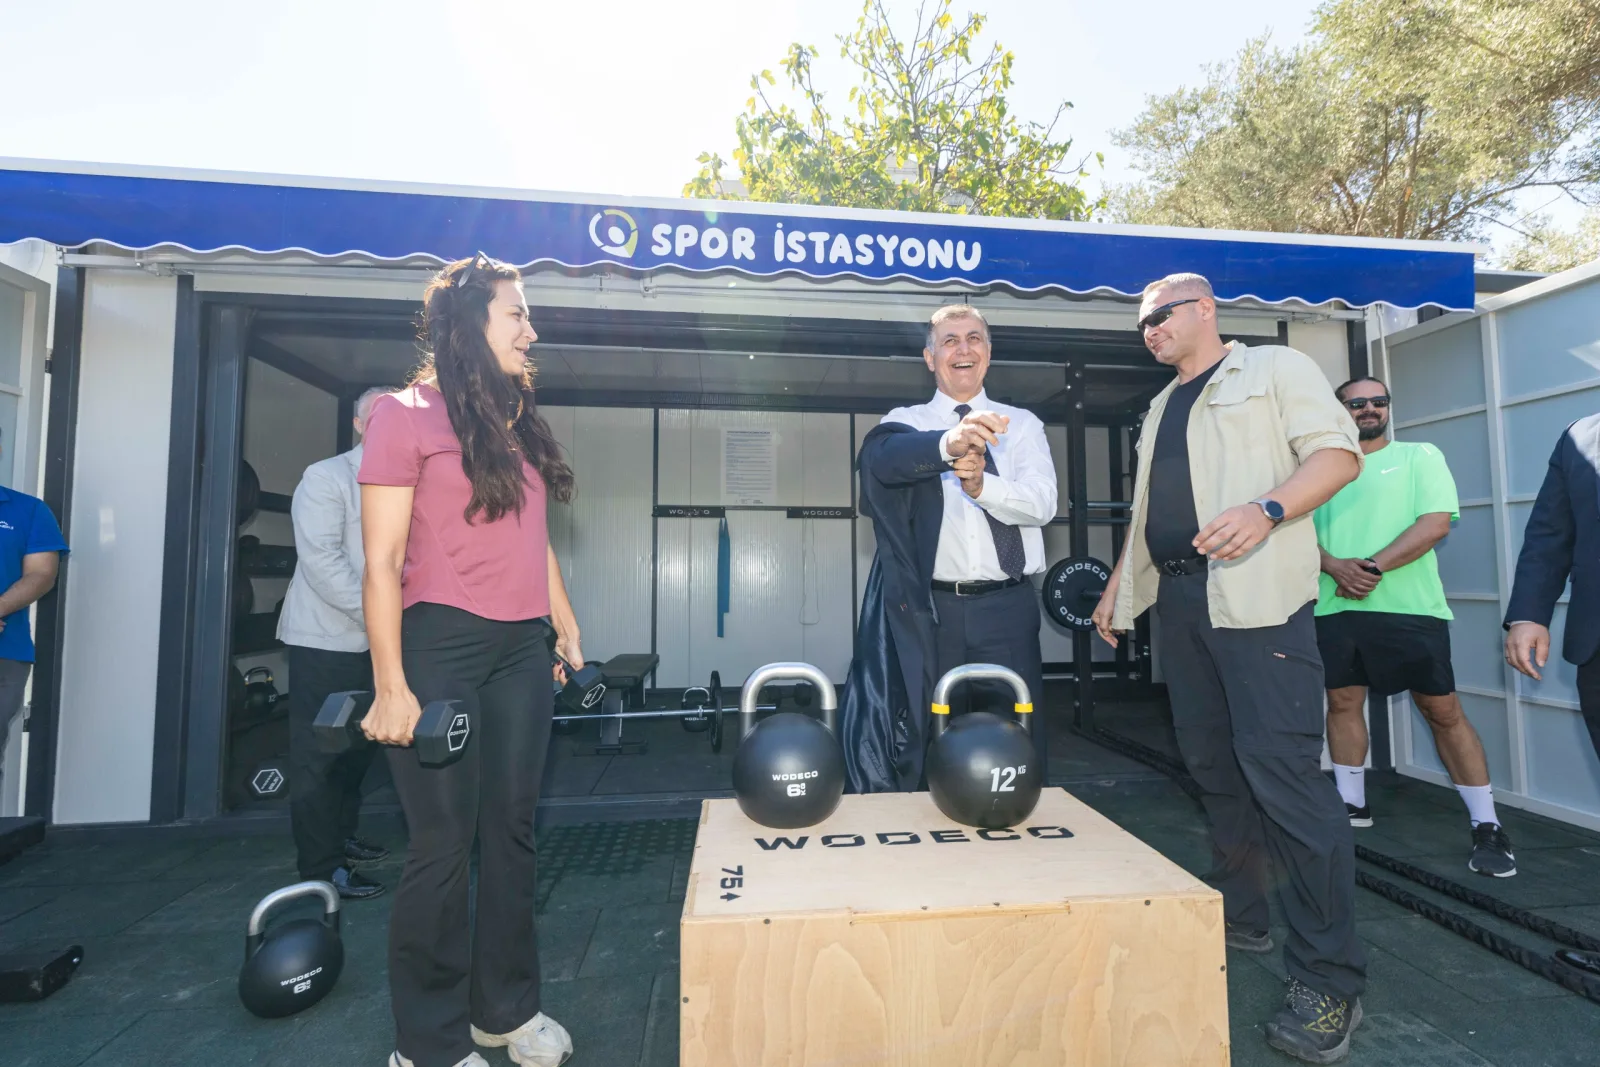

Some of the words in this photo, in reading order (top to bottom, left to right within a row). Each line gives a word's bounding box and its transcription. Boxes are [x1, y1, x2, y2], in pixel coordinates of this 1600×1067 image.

[651, 223, 756, 261] SPOR
[774, 222, 982, 272] İSTASYONU
[1058, 563, 1108, 582] WODECO
[1060, 606, 1092, 625] DECO
[772, 770, 819, 781] WODECO
[754, 826, 1075, 851] WODECO
[720, 865, 743, 889] 75
[280, 966, 322, 987] WODECO
